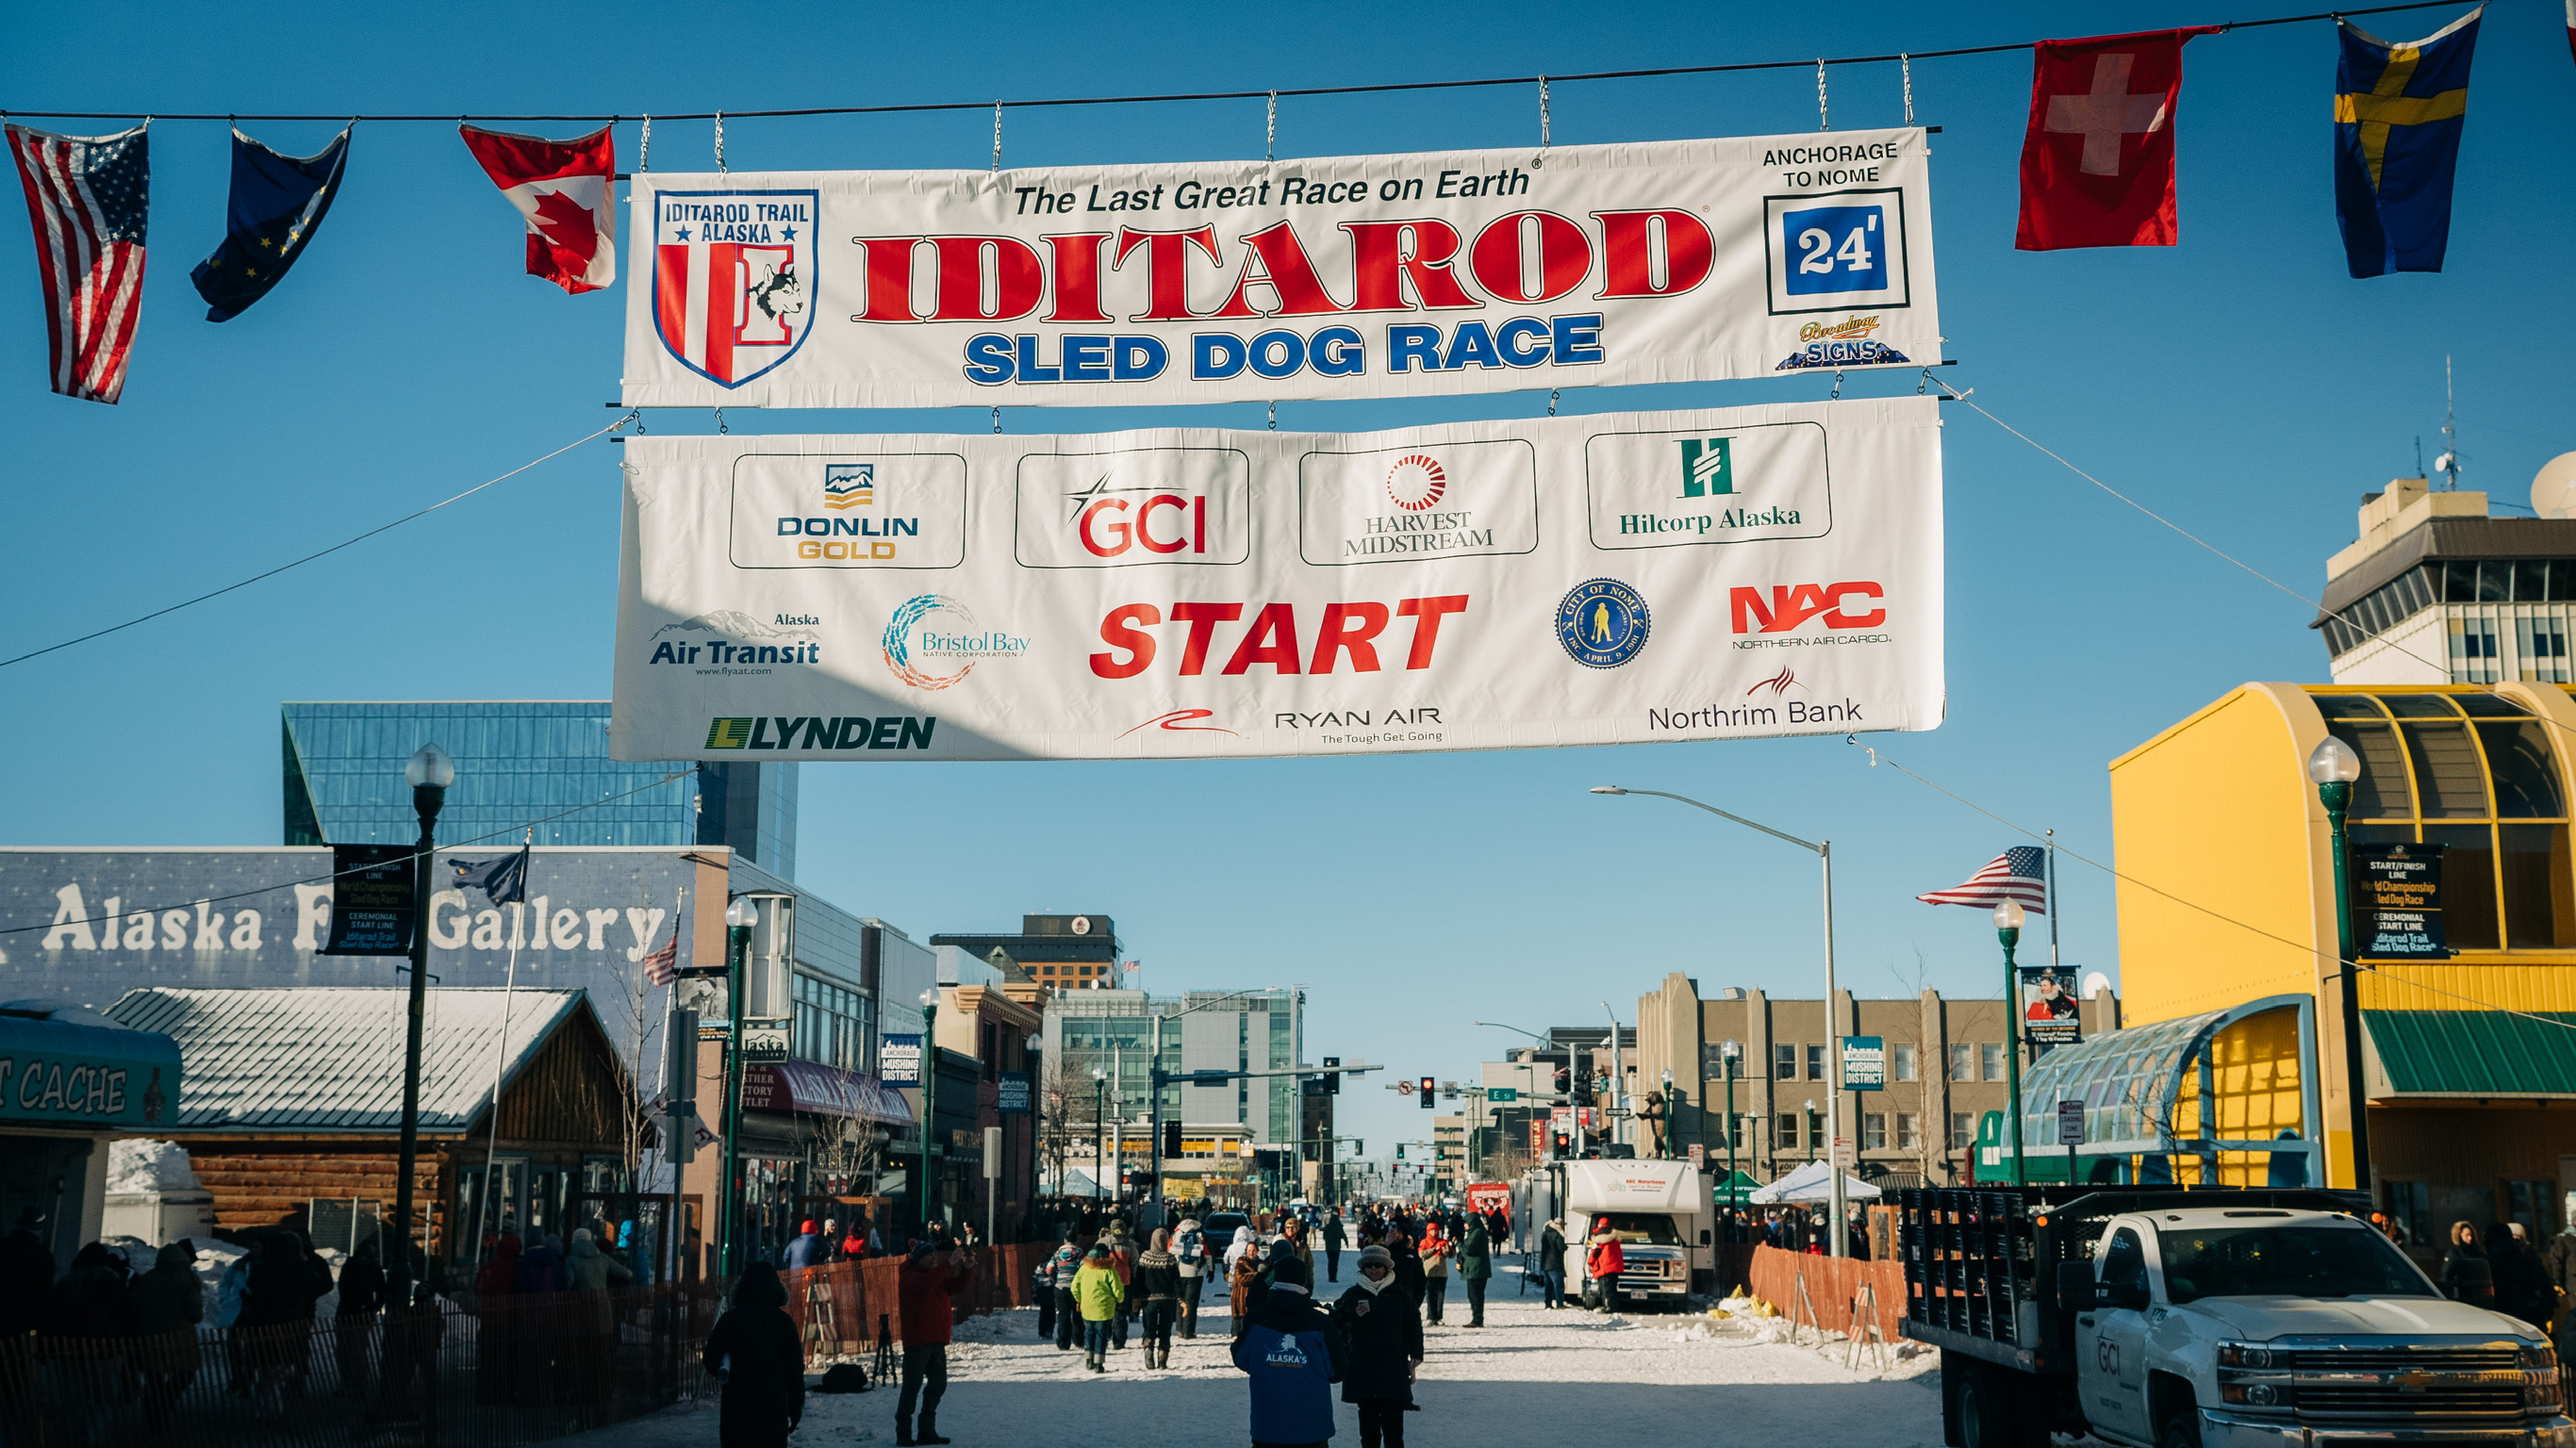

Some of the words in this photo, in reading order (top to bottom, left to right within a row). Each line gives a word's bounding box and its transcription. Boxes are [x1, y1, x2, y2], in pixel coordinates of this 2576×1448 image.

[1762, 142, 1898, 167] ANCHORAGE
[1783, 172, 1812, 187] TO
[1818, 167, 1879, 186] NOME
[1016, 187, 1076, 215] The
[1087, 181, 1161, 212] Last
[1174, 179, 1270, 210] Great
[1280, 173, 1366, 206] Race
[1379, 177, 1423, 201] on
[666, 203, 751, 223] IDITAROD
[756, 204, 808, 222] TRAIL
[701, 222, 771, 244] ALASKA
[851, 206, 1716, 325] IDITAROD
[1800, 315, 1880, 342] Broadway
[963, 332, 1169, 387] SLED
[1191, 322, 1365, 384] DOG
[1386, 313, 1605, 375] RACE
[1806, 339, 1878, 363] SIGNS
[777, 517, 918, 537] DONLIN
[1079, 493, 1206, 558] GCI
[1365, 512, 1471, 535] HARVEST
[1619, 514, 1712, 535] Hilcorp
[1719, 506, 1802, 529] Alaska
[798, 540, 896, 560] GOLD
[1344, 529, 1494, 556] MIDSTREAM
[1565, 590, 1586, 615] CITY
[1589, 584, 1605, 595] OF
[1610, 586, 1641, 613] NOME
[1729, 581, 1887, 634] NAC
[774, 614, 820, 626] Alaska
[922, 632, 988, 651] Bristol
[993, 633, 1032, 656] Bay
[1089, 595, 1469, 680] START
[1732, 637, 1809, 650] NORTHERN
[1812, 636, 1835, 647] AIR
[649, 640, 702, 665] Air
[706, 640, 820, 665] Transit
[1568, 636, 1581, 653] INC.
[1584, 652, 1613, 663] APRIL
[1626, 634, 1640, 652] 1901
[696, 667, 772, 677] www.flyaat.com
[1275, 710, 1370, 729] RYAN
[1383, 707, 1443, 725] AIR
[1649, 703, 1776, 731] Northrim
[1788, 698, 1863, 724] Bank
[748, 716, 937, 750] LYNDEN
[1321, 734, 1343, 744] The
[1345, 733, 1379, 746] Tough
[1383, 732, 1405, 742] Get
[1408, 731, 1443, 744] Going
[2370, 862, 2426, 870] START/FINISH
[2388, 871, 2407, 880] LINE
[2361, 880, 2381, 892] World
[2383, 881, 2436, 895] Championship
[2374, 894, 2390, 904] Sled
[2390, 894, 2404, 907] Dog
[2405, 895, 2424, 905] Race
[41, 882, 263, 950] Alaska
[349, 913, 398, 921] CEREMONIAL
[351, 921, 375, 930] START
[428, 889, 666, 963] Gallery
[2373, 913, 2425, 922] CEREMONIAL
[2377, 922, 2403, 930] START
[2404, 923, 2424, 931] LINE
[2371, 943, 2390, 951] Sled
[2391, 944, 2410, 952] Dog
[2408, 933, 2429, 943] Trail
[745, 1039, 784, 1051] laska
[883, 1059, 918, 1070] MUSHING
[1845, 1061, 1883, 1073] MUSHING
[883, 1070, 917, 1081] DISTRICT
[1845, 1073, 1882, 1084] DISTRICT
[20, 1060, 126, 1115] CACHE
[1494, 1091, 1499, 1099] E
[1266, 1353, 1308, 1364] ALASKA'S
[2098, 1341, 2121, 1376] GCI
